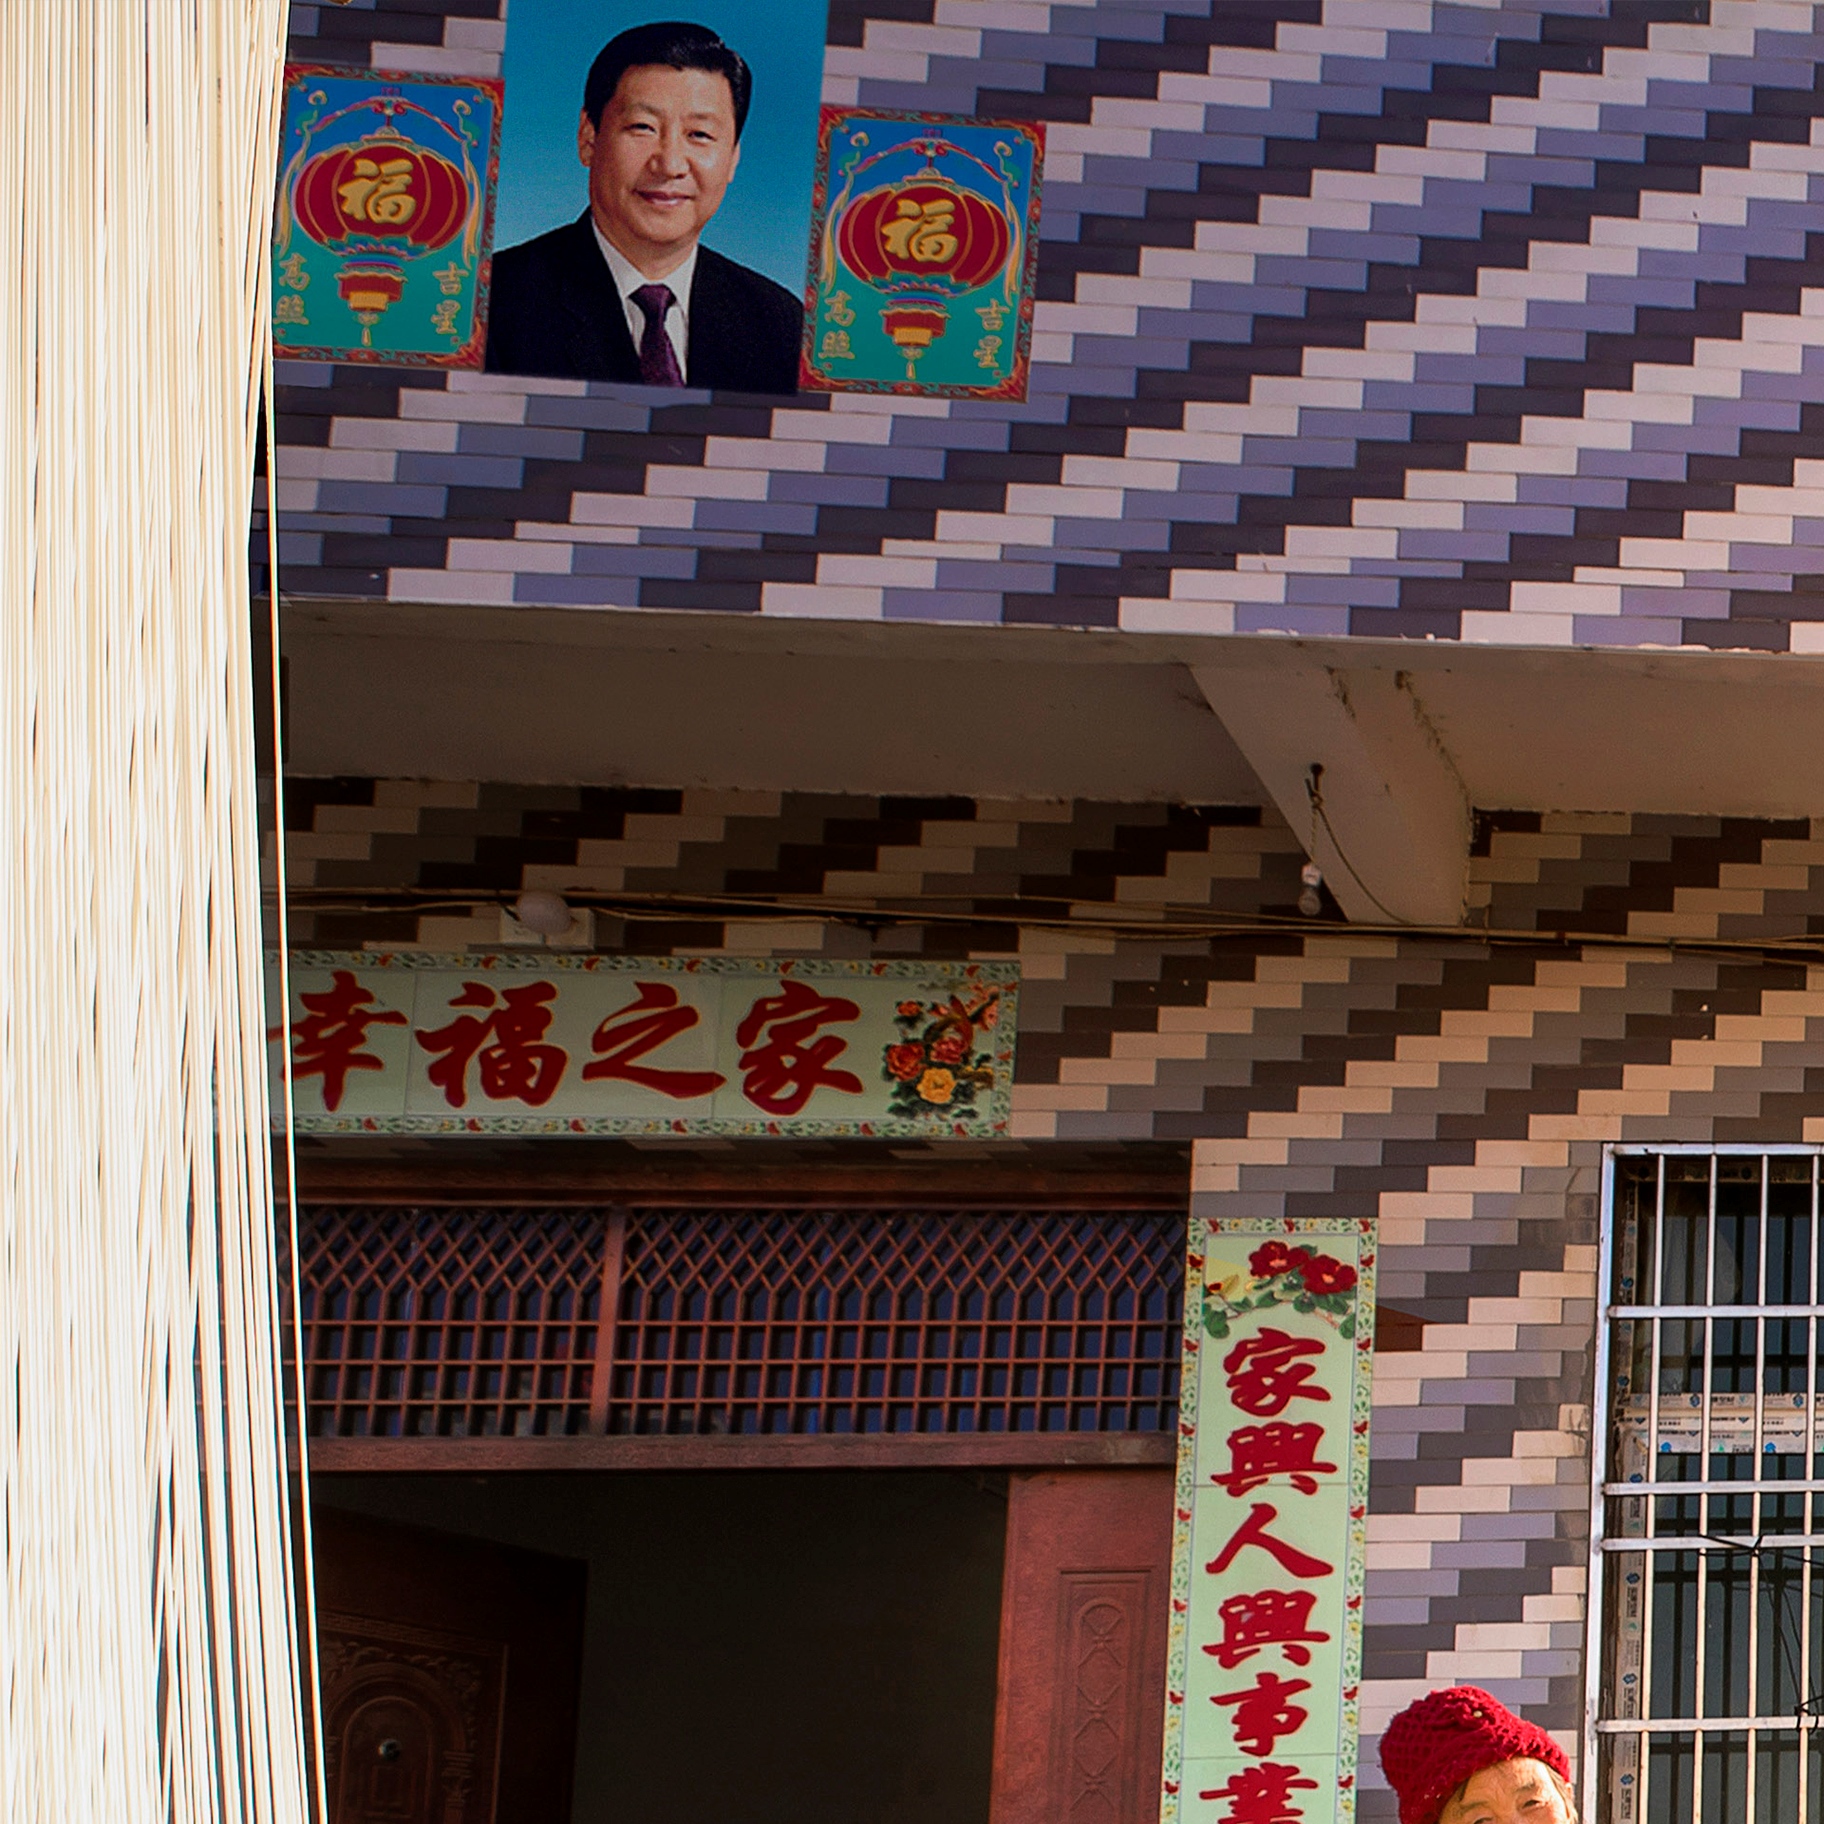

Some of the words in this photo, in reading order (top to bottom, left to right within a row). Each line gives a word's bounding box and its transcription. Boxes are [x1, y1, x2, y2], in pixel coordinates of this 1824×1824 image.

[338, 157, 416, 225] 福
[880, 198, 958, 263] 福
[268, 970, 866, 1116] 幸福之家
